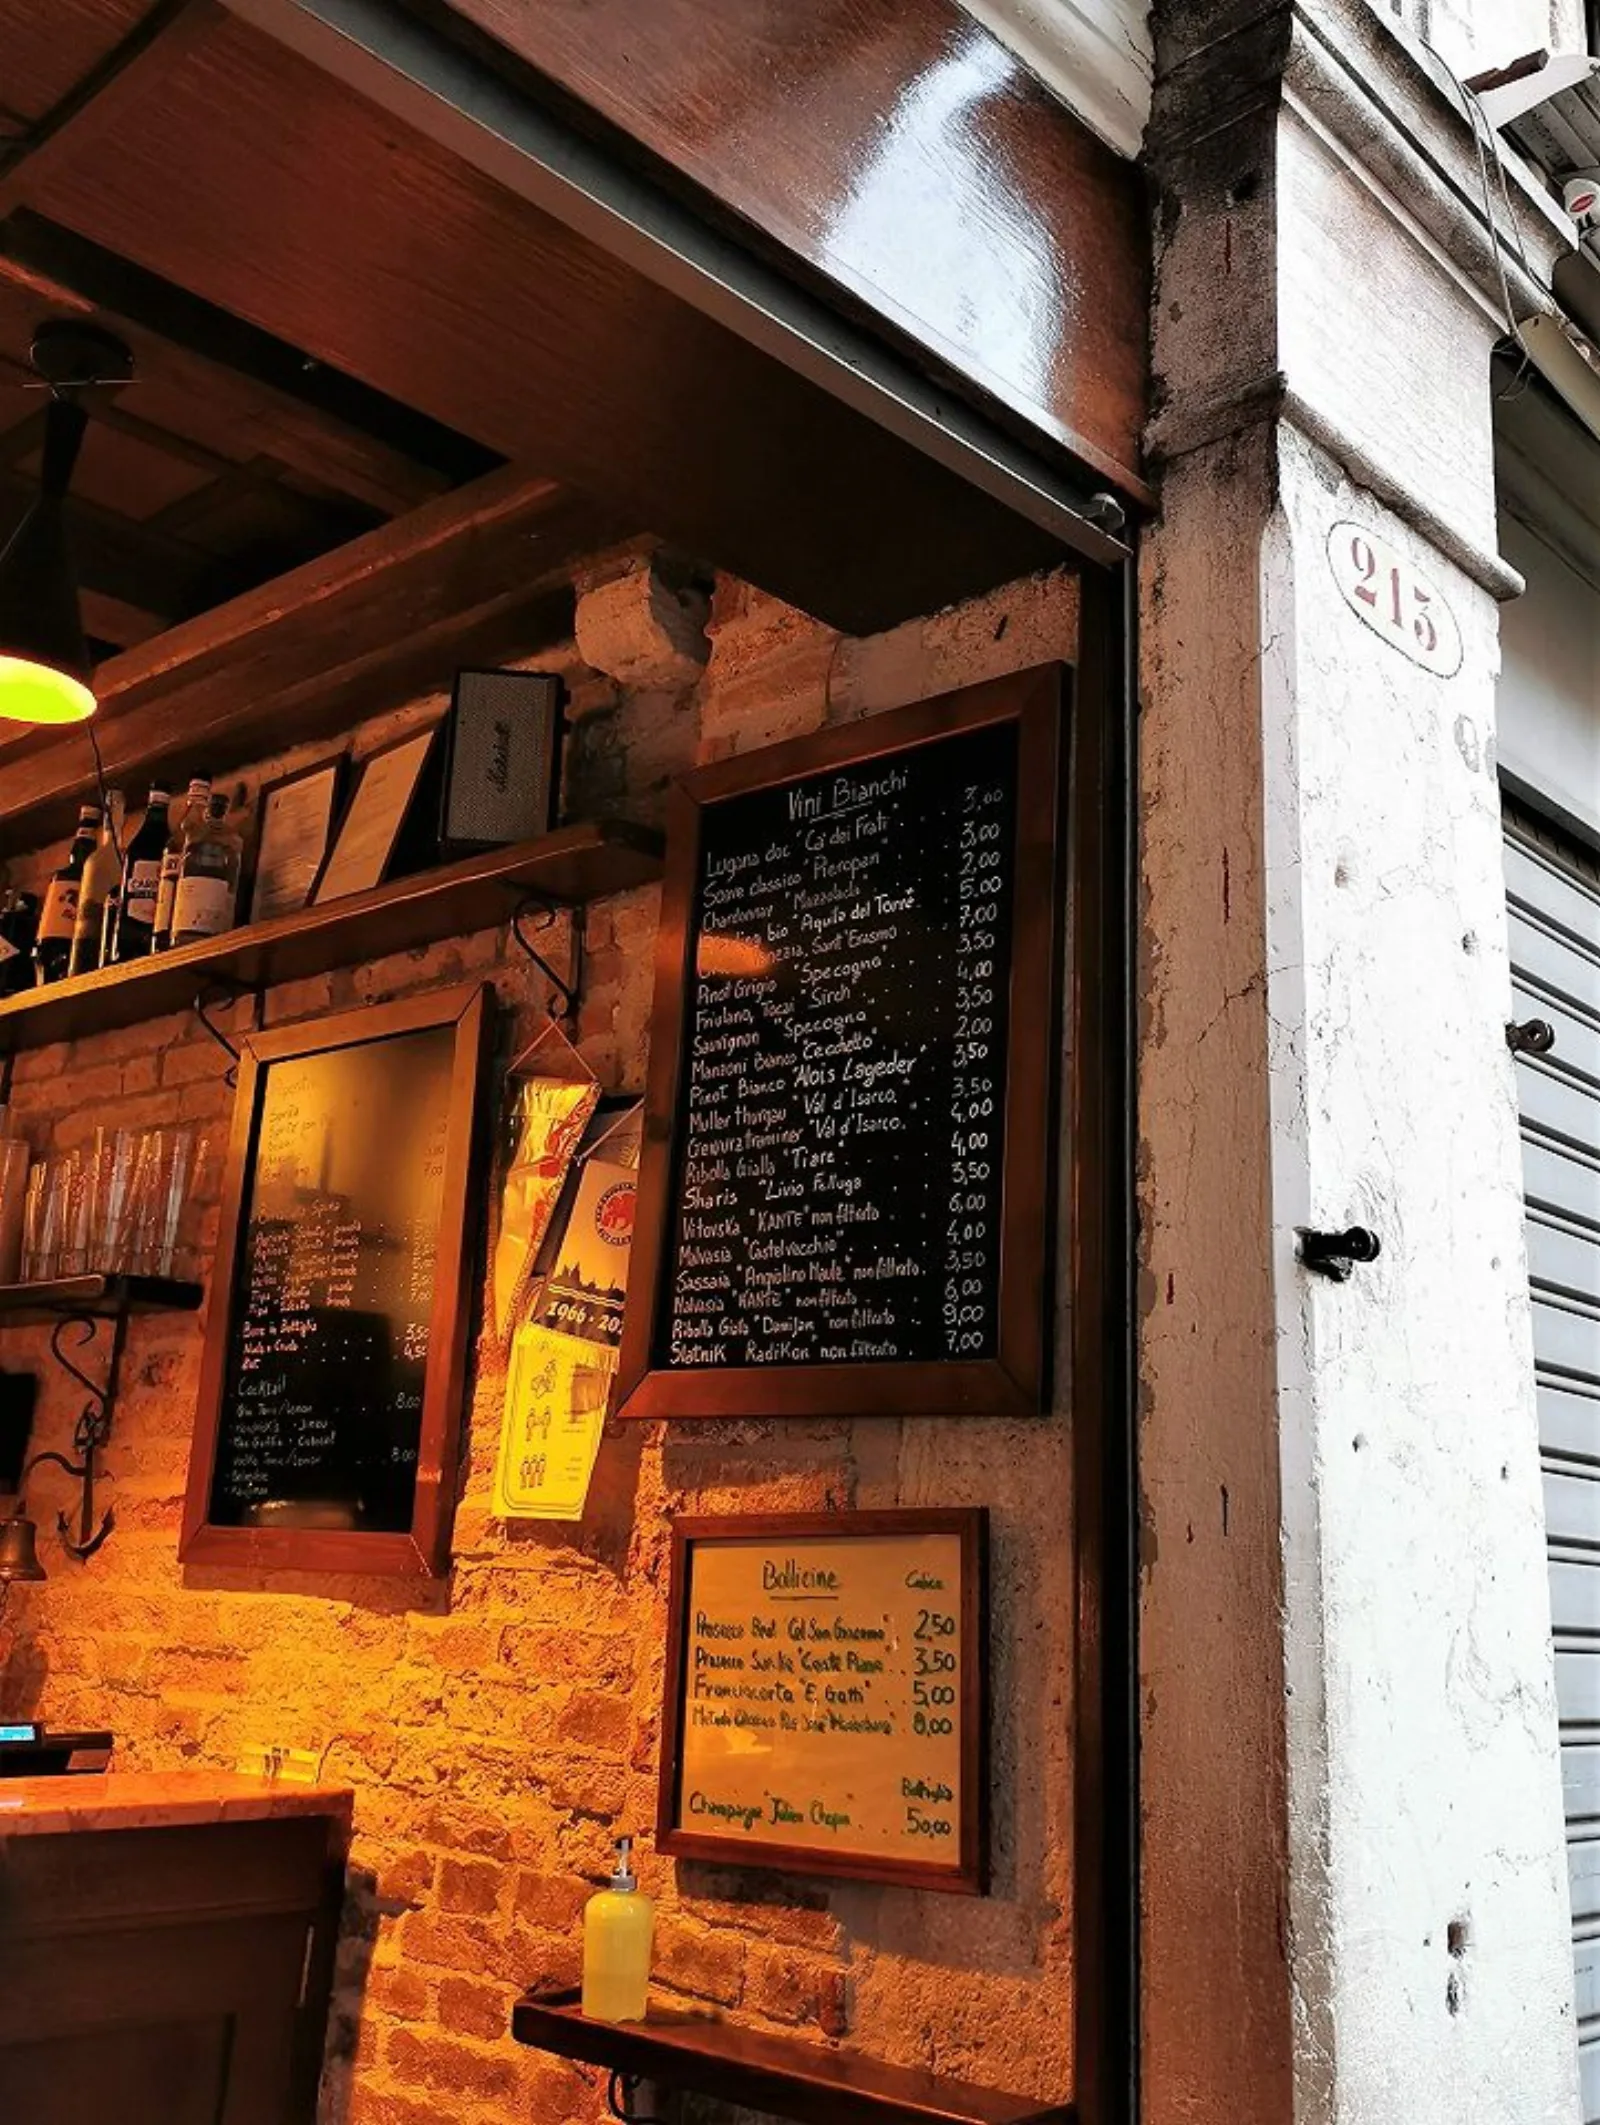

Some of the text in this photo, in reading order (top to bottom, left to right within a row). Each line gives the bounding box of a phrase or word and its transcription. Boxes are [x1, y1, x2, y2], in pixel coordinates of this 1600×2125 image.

[788, 766, 909, 821] Vini Bianchi
[707, 852, 760, 882] Lugana
[765, 843, 791, 862] doc
[829, 826, 851, 845] dei
[750, 873, 801, 896] classico
[960, 821, 1000, 849] 3,00
[959, 851, 1001, 876] 2,00
[767, 923, 789, 942] bio
[851, 902, 870, 920] del
[959, 902, 997, 928] 7,00
[698, 984, 731, 1006] Pinot
[734, 977, 777, 1003] Grigio
[956, 929, 995, 953] 3,50
[957, 960, 993, 981] 4,00
[693, 1032, 760, 1056] Sauvignon
[956, 984, 993, 1011] 3,50
[692, 1058, 749, 1083] Manzoni
[953, 1015, 992, 1038] 2,00
[690, 1085, 729, 1107] Pinot
[738, 1077, 786, 1099] Bianco
[952, 1042, 988, 1068] 3,50
[951, 1076, 992, 1099] 3,50
[951, 1130, 988, 1156] 4,00
[682, 1187, 738, 1210] Sharis
[952, 1162, 990, 1186] 3,50
[811, 1210, 833, 1226] non
[949, 1193, 986, 1213] 6,00
[679, 1245, 732, 1266] Malvasia
[944, 1250, 985, 1272] 3,50
[945, 1278, 982, 1302] 6,00
[546, 1301, 587, 1324] 1966
[942, 1303, 984, 1327] 9,00
[820, 1344, 848, 1360] non
[946, 1330, 984, 1353] 7,00
[763, 1558, 840, 1590] Bollicine
[913, 1647, 956, 1675] 3,50
[912, 1680, 955, 1708] 5,00
[913, 1711, 952, 1738] 8,00
